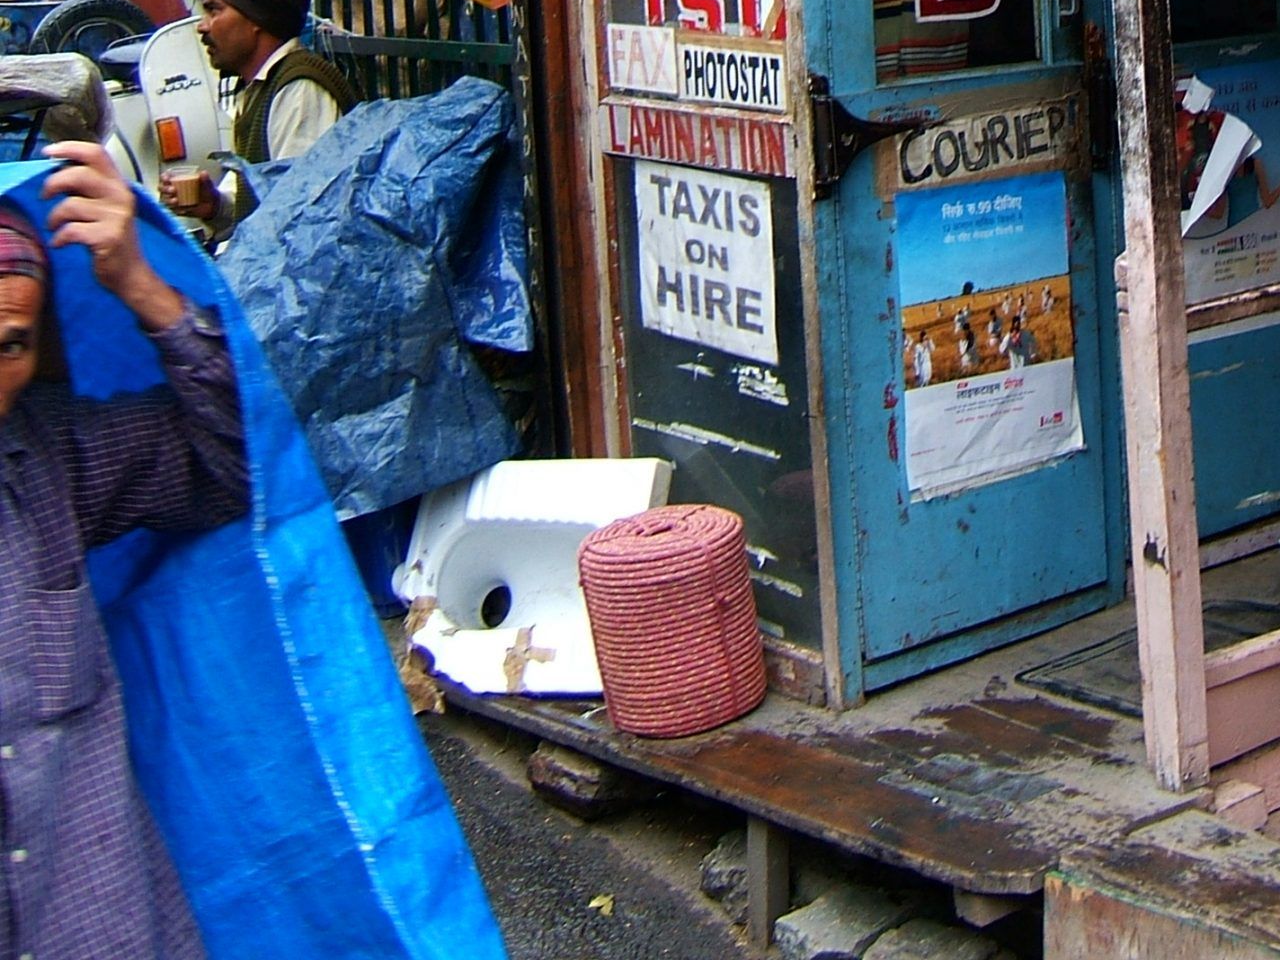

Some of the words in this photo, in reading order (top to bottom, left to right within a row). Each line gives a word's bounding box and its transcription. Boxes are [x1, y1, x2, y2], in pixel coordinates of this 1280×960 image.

[612, 28, 671, 91] FAX
[684, 50, 781, 106] PHOTOSTAT
[608, 103, 787, 178] LAMINATION
[650, 175, 762, 237] TAXIS
[685, 238, 730, 272] ON
[656, 266, 764, 334] HIRE
